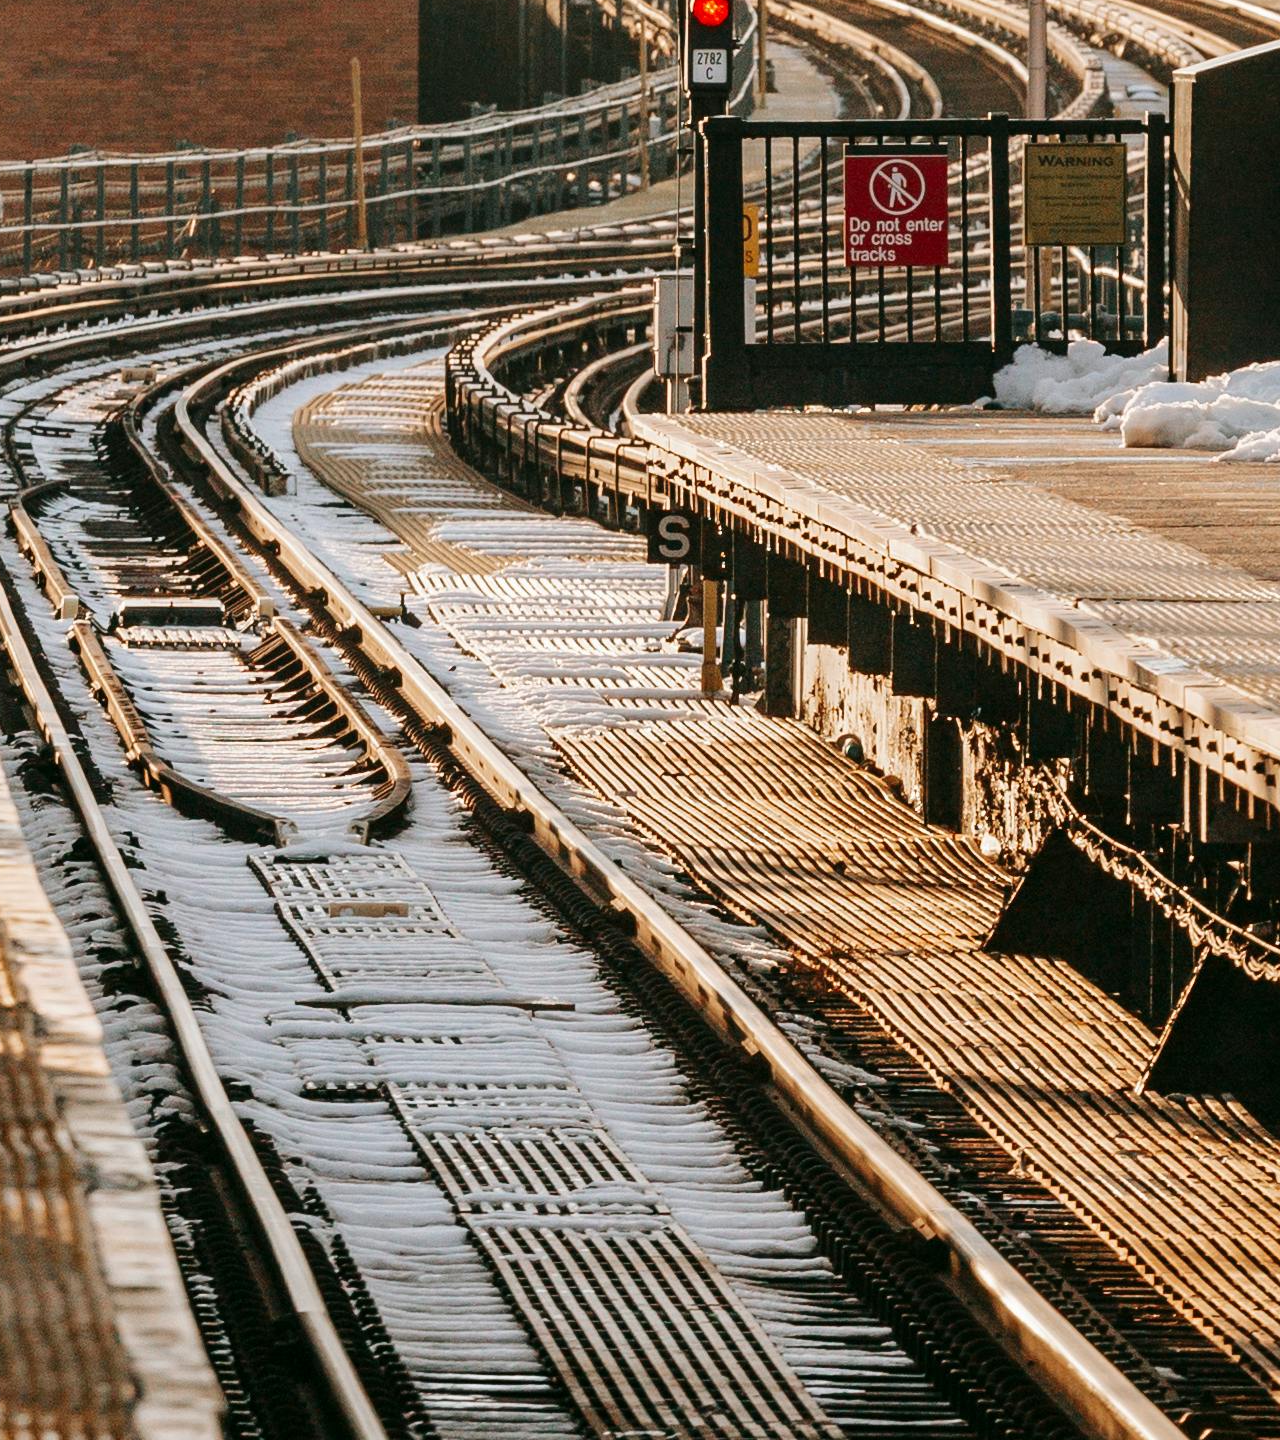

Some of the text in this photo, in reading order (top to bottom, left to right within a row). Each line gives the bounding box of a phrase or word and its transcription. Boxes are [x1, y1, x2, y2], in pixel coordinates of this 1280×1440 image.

[697, 52, 722, 65] 2782
[706, 67, 713, 80] C
[1038, 155, 1114, 167] WARNING
[850, 217, 944, 232] Do not enter
[850, 233, 912, 246] or cross
[850, 246, 896, 261] tracks
[658, 515, 690, 558] S
